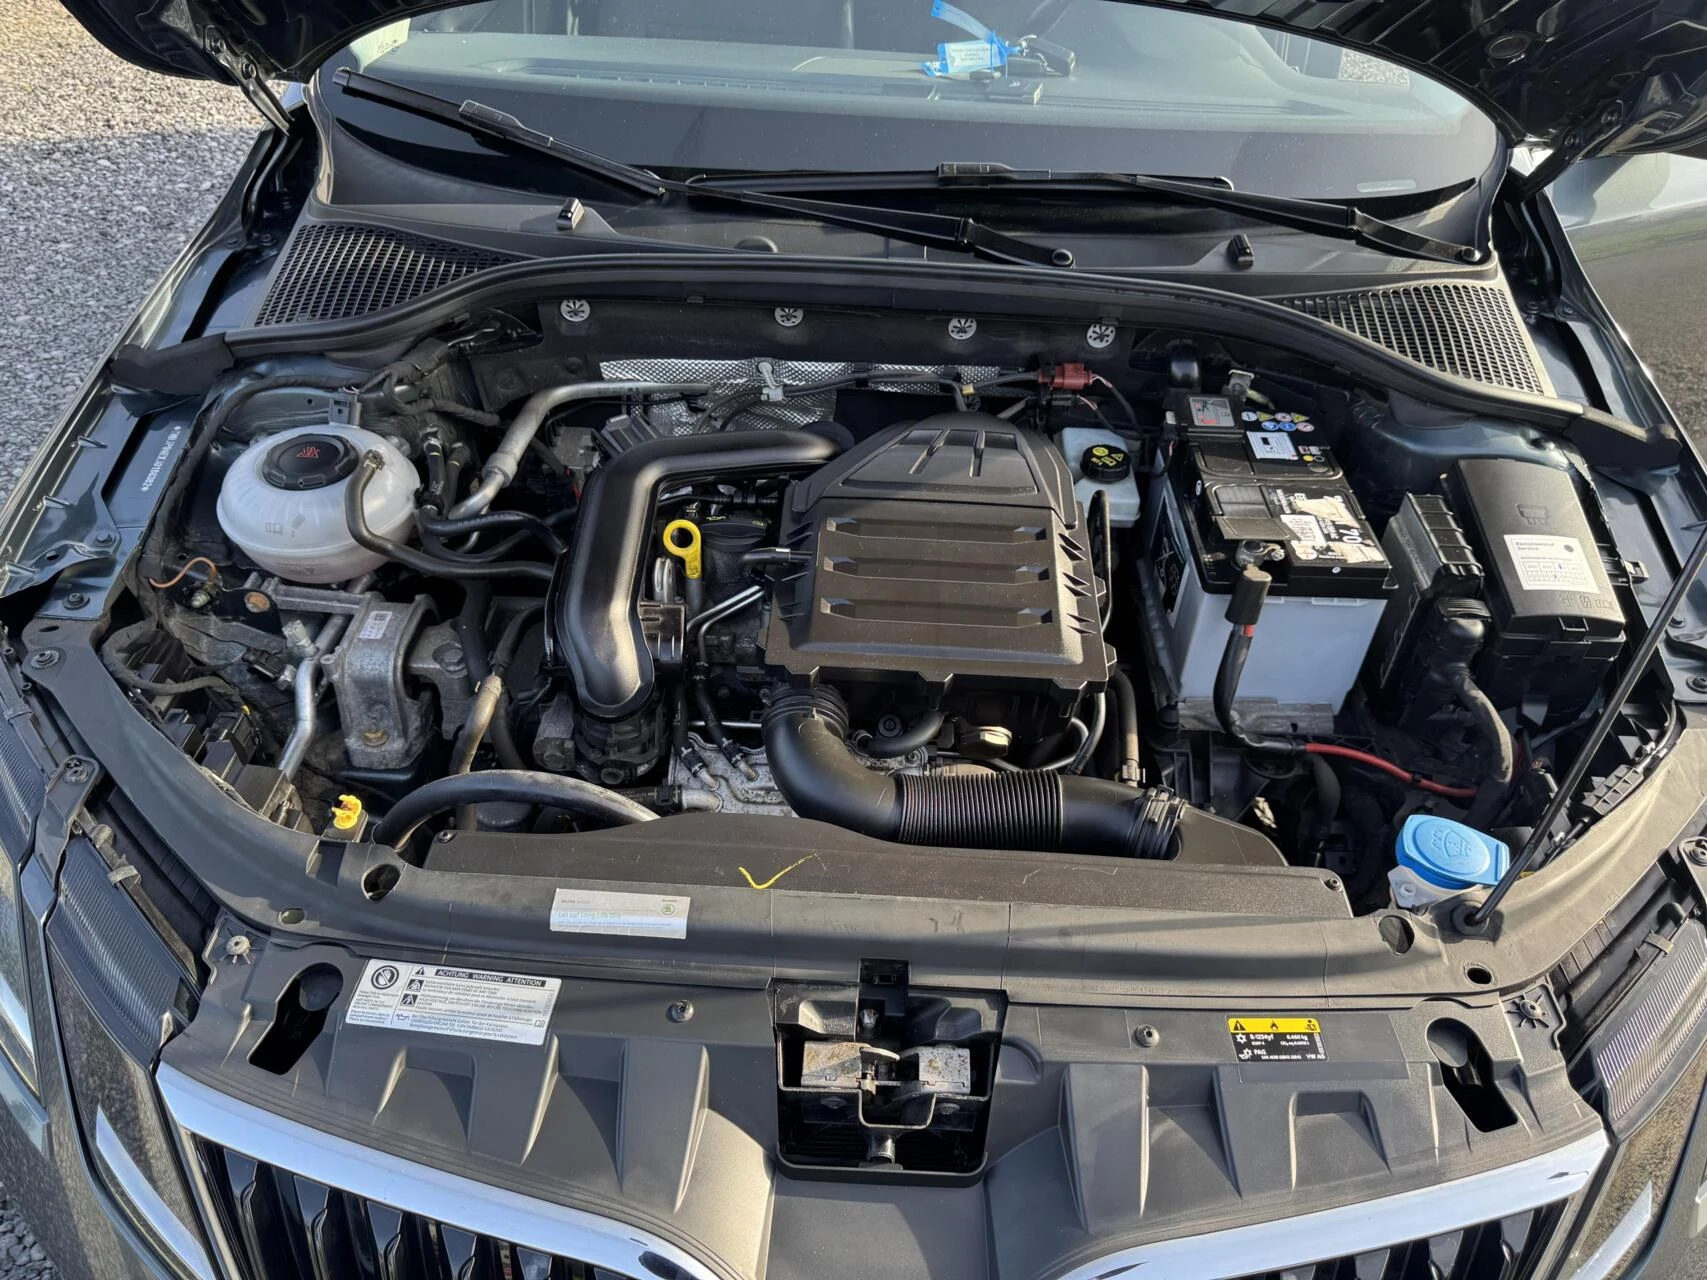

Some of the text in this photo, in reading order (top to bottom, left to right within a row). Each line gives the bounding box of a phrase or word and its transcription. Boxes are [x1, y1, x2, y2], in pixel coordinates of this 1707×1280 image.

[438, 970, 469, 979] ACHTUNG
[472, 974, 503, 982] WARNING
[506, 977, 542, 986] ATTENTION
